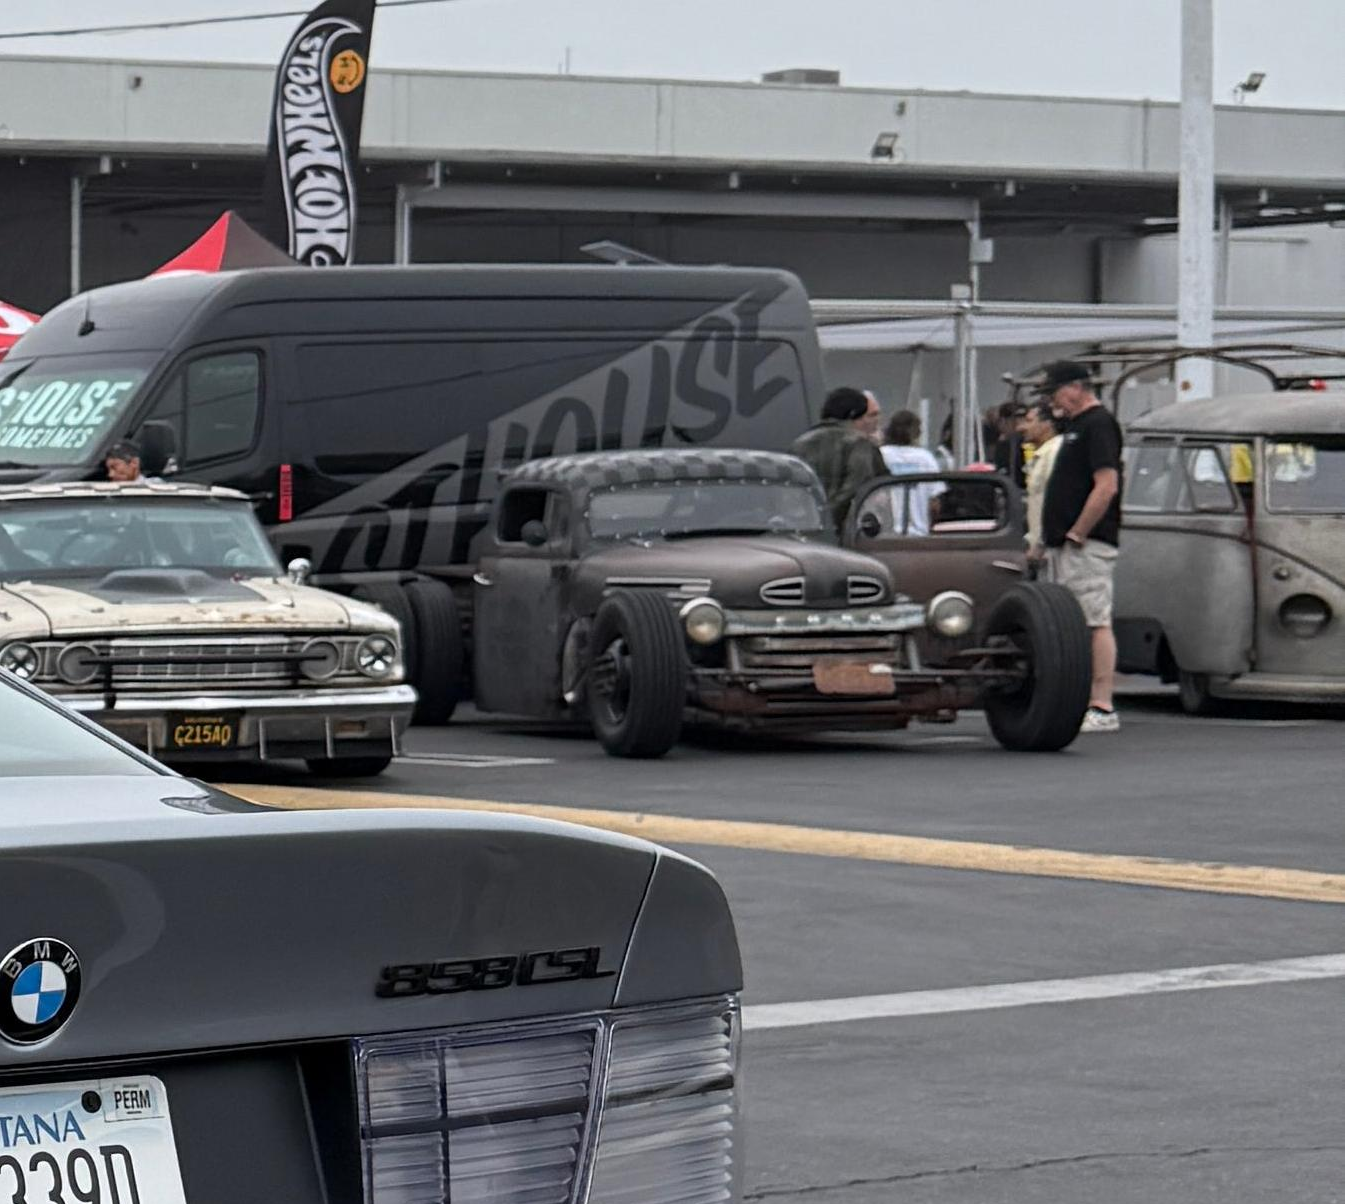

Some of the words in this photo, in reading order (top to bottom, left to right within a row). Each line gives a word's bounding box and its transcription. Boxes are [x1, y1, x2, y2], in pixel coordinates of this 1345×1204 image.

[295, 167, 350, 261] HOT
[2, 941, 79, 980] BMW
[113, 1089, 152, 1110] PERM
